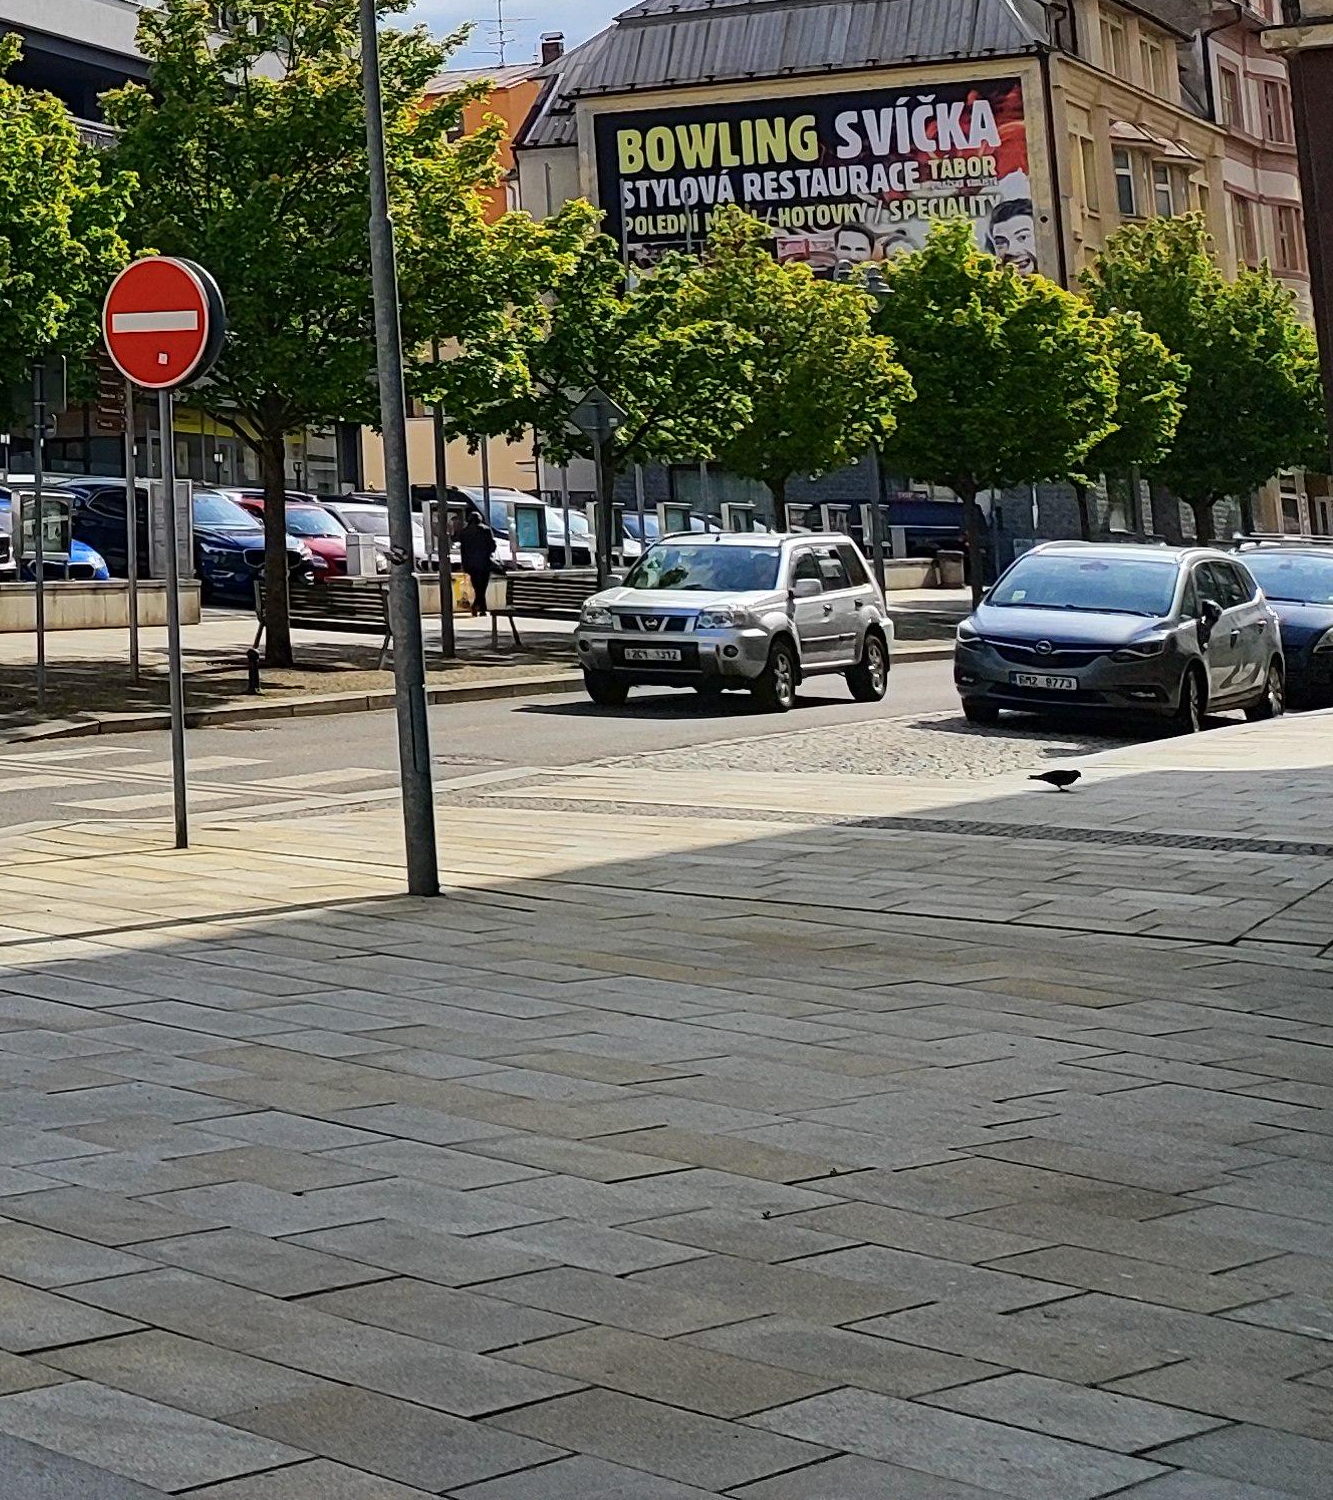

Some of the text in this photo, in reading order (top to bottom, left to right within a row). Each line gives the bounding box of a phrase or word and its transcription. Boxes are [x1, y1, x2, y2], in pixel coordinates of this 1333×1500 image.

[617, 94, 1002, 174] BOWLING SVÍČKA
[624, 161, 920, 209] STYLOVÁ RESTAURACE
[928, 154, 997, 179] TÁBOR
[778, 202, 869, 228] HOTOVKY
[889, 195, 1002, 222] SPECIALITY
